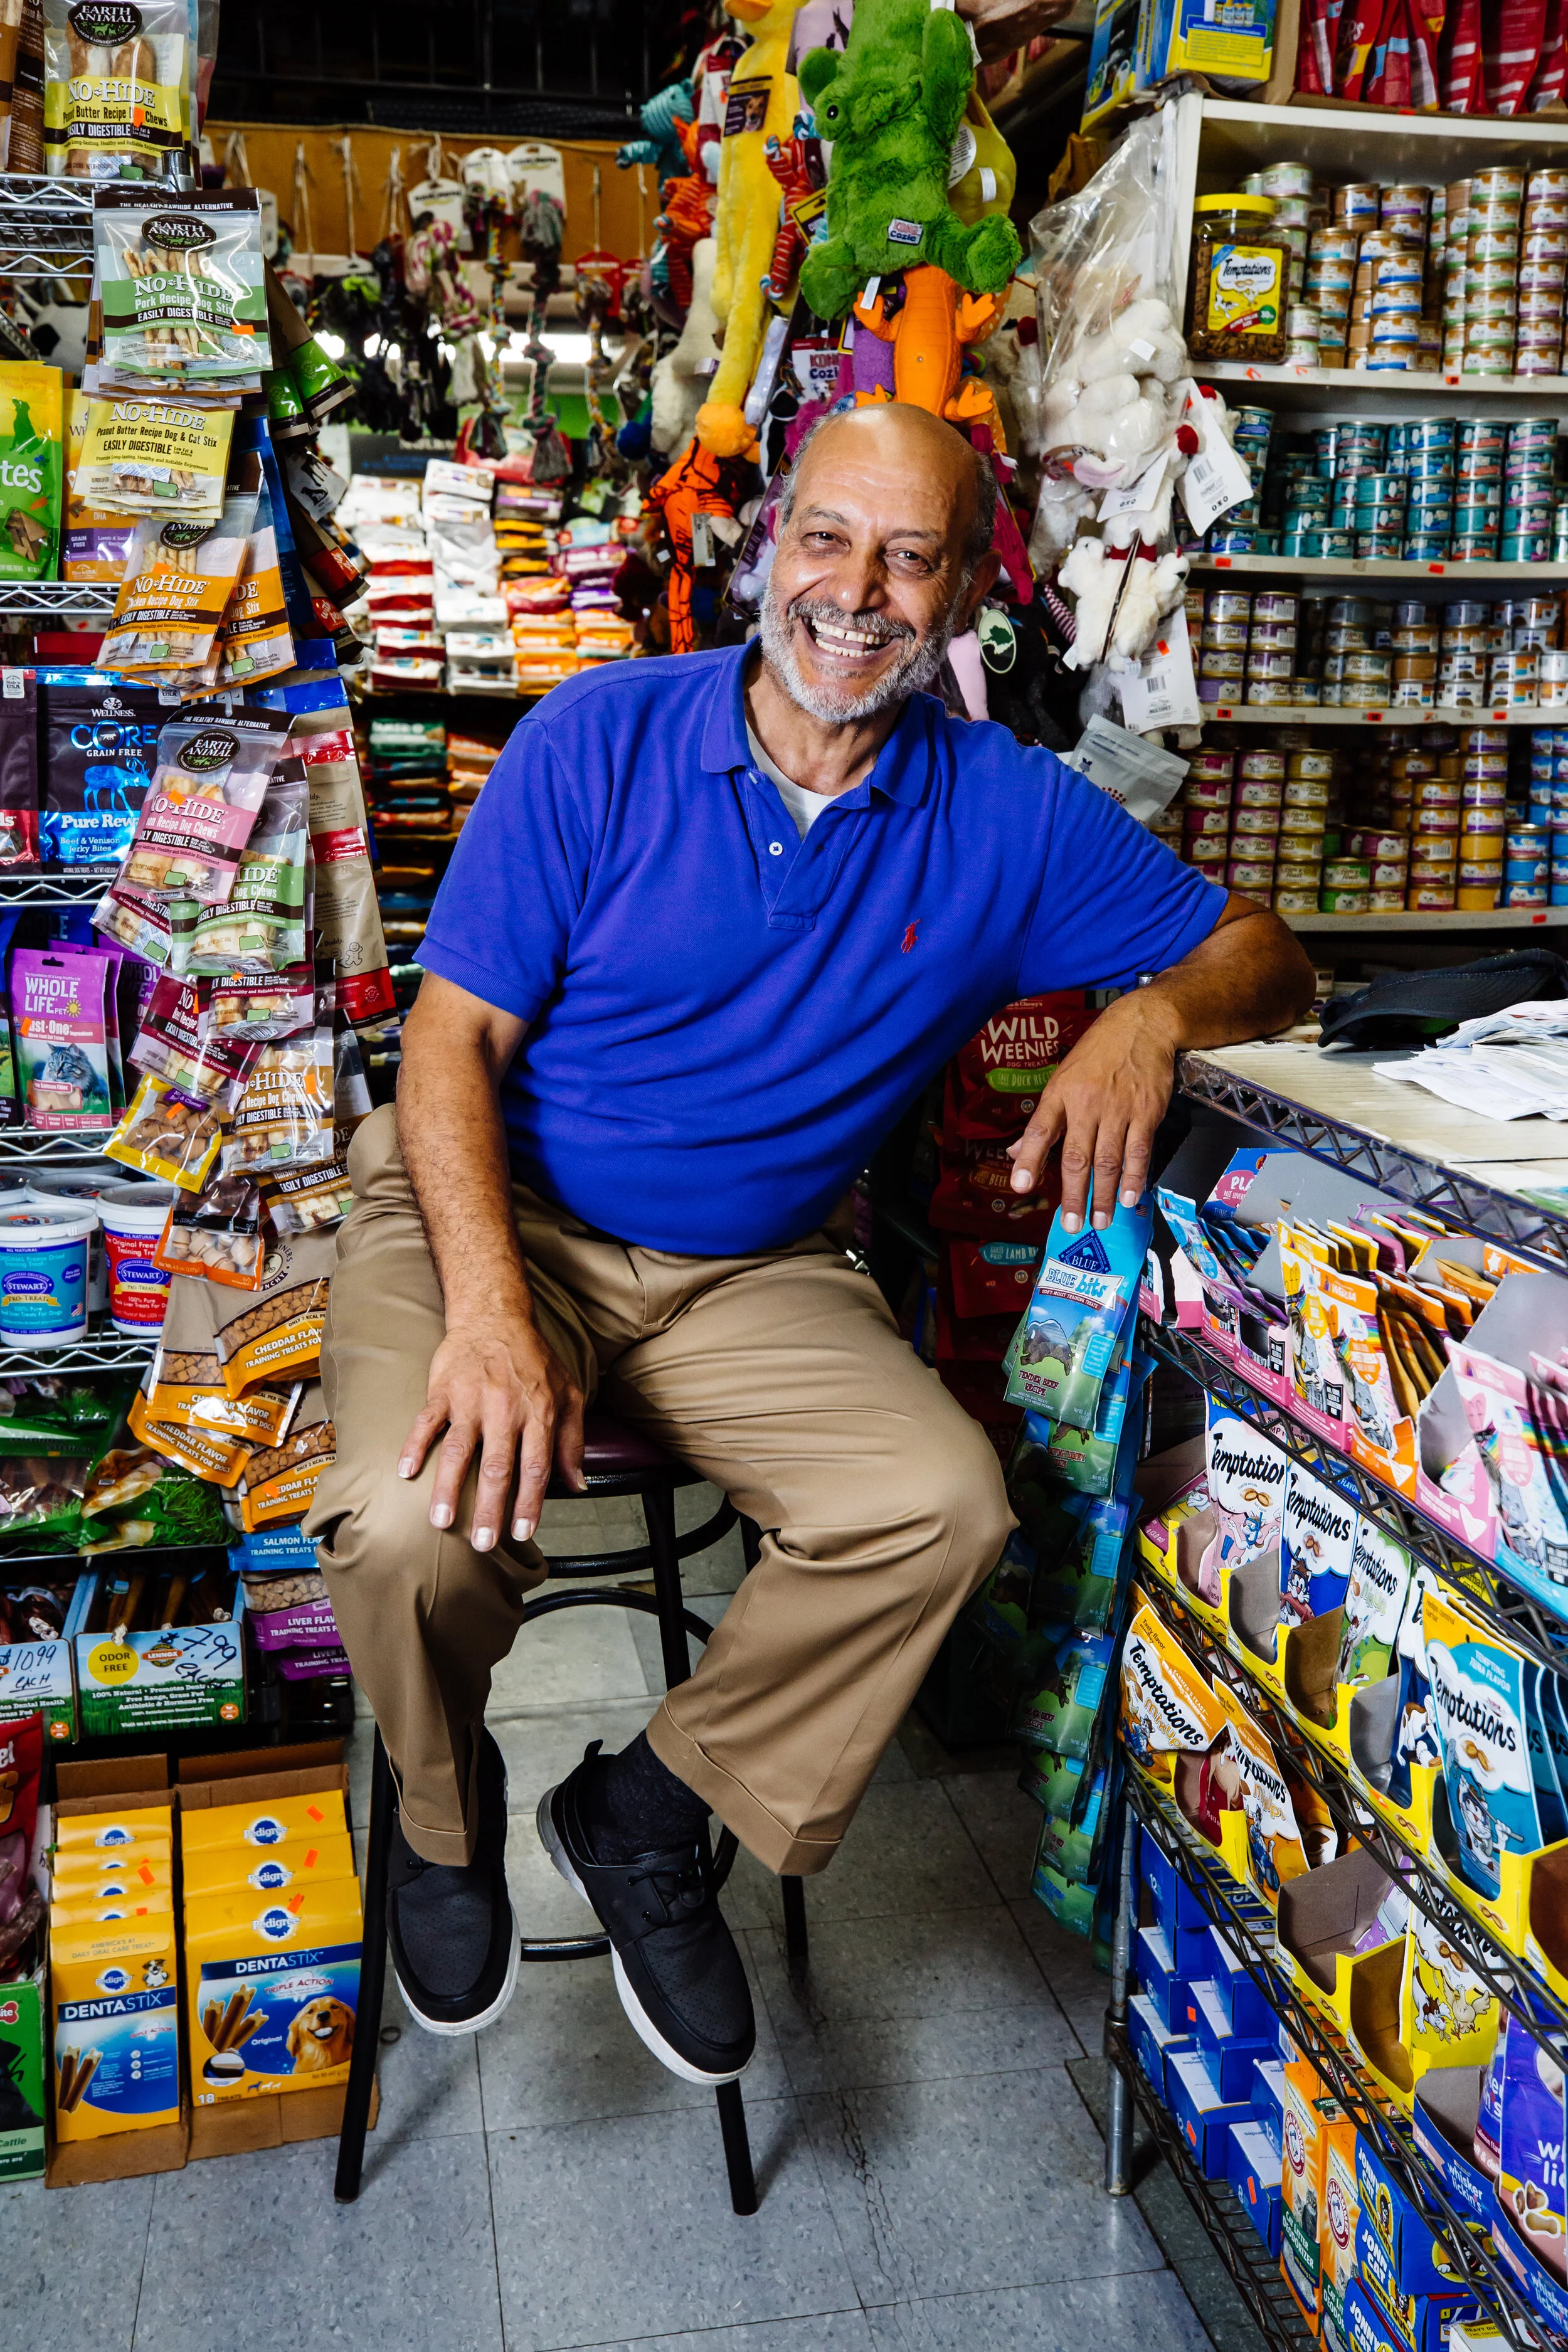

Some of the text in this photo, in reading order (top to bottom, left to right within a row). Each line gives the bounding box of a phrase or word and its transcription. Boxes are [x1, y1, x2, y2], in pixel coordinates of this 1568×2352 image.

[82, 5, 130, 15] EARTH
[75, 13, 135, 23] ANIMAL
[76, 106, 100, 119] Butter
[103, 107, 125, 120] Recipe
[146, 111, 167, 127] Chews
[88, 124, 130, 136] DIGESTIBLE
[148, 228, 211, 237] ANIMAL
[153, 221, 203, 232] EARTH
[893, 220, 918, 235] KONG
[890, 230, 916, 242] Cozie
[1223, 258, 1271, 279] Temptations
[135, 294, 231, 314] Pork Recipe Stix
[138, 309, 164, 322] EASILY
[97, 426, 217, 447] Peanut Butter Recipe Dog & Cat Stix
[103, 440, 172, 455] EASILY DIGESTIBLE
[184, 462, 208, 470] Enjoyment
[147, 596, 199, 607] Recipe Dog Stix
[137, 610, 171, 621] DIGESTIBLE
[215, 718, 236, 726] RAWHIDE
[237, 720, 270, 729] ALTERNATIVE
[70, 720, 156, 751] CORE
[194, 739, 235, 749] EARTH
[87, 749, 115, 757] GRAIN
[186, 747, 232, 757] ANIMAL
[61, 815, 99, 829] Pure
[157, 817, 218, 839] Recipe Dog Chews
[152, 831, 189, 847] DIGESTIBLE
[233, 886, 248, 898] Dog
[216, 901, 255, 919] DIGESTIBLE
[24, 977, 79, 999] WHOLE
[221, 975, 263, 987] DIGESTIBLE
[24, 995, 55, 1014] LIFE
[987, 1017, 1059, 1044] WILD
[980, 1039, 1059, 1065] WEENIES
[1024, 1059, 1048, 1067] TREATS
[1012, 1074, 1031, 1086] DUCK
[246, 1093, 279, 1109] Recipe Dog
[246, 1108, 282, 1123] DIGESTIBLE
[280, 1165, 343, 1192] EASILY DIGESTIBLE
[988, 1173, 1008, 1186] BEEF
[112, 1239, 137, 1248] Original
[117, 1248, 142, 1257] Training
[1006, 1248, 1026, 1259] LAMB
[1071, 1255, 1098, 1272] BLUE
[122, 1270, 159, 1279] STEWART
[8, 1282, 44, 1290] STEWART
[1046, 1268, 1108, 1298] BLUE bits
[1042, 1288, 1098, 1309] SOFT-MOIST TRAINING TREATS
[253, 1335, 296, 1356] CHEDDAR
[245, 1341, 307, 1369] TRAINING TREATS
[1017, 1369, 1060, 1390] TENDER BEEF
[1024, 1382, 1046, 1397] RECIPE
[259, 1421, 274, 1432] DOGS
[144, 1422, 232, 1473] TRAINING TREATS FOR DOGS
[159, 1422, 228, 1463] CHEDDAR FLAVOR
[257, 1488, 312, 1510] TRAINING TREATS
[1286, 1473, 1352, 1541] Temptations
[263, 1537, 300, 1546] SALMON
[251, 1547, 283, 1555] TRAINING
[288, 1617, 312, 1625] LIVER
[270, 1626, 331, 1636] TRAINING TREATS
[1142, 1618, 1166, 1650] Tasty flavor
[99, 1653, 130, 1662] ODOR
[1475, 1649, 1506, 1679] TEMPTING
[104, 1663, 128, 1672] FREE
[1486, 1667, 1512, 1694] FLAVOR
[1129, 1638, 1204, 1746] Temptations
[1192, 1694, 1206, 1715] FEAST
[1430, 1655, 1517, 1752] Temptations
[243, 1826, 287, 1839] Pedigree
[247, 1871, 293, 1883] Pedigree
[252, 1916, 299, 1931] Pedigree
[236, 1952, 319, 1974] DENTASTIX
[264, 1982, 294, 1994] TRIPLE
[297, 1978, 334, 1986] ACTION
[65, 1993, 162, 2020] DENTASTIX
[251, 2035, 282, 2046] Original
[197, 2093, 215, 2106] 18
[1362, 2168, 1374, 2201] CAT
[1447, 2163, 1483, 2200] whisker
[1453, 2176, 1483, 2213] lickin's
[1285, 2210, 1309, 2250] CAT LITTER
[1283, 2215, 1315, 2270] DEODORIZER
[1367, 2251, 1385, 2286] CAT
